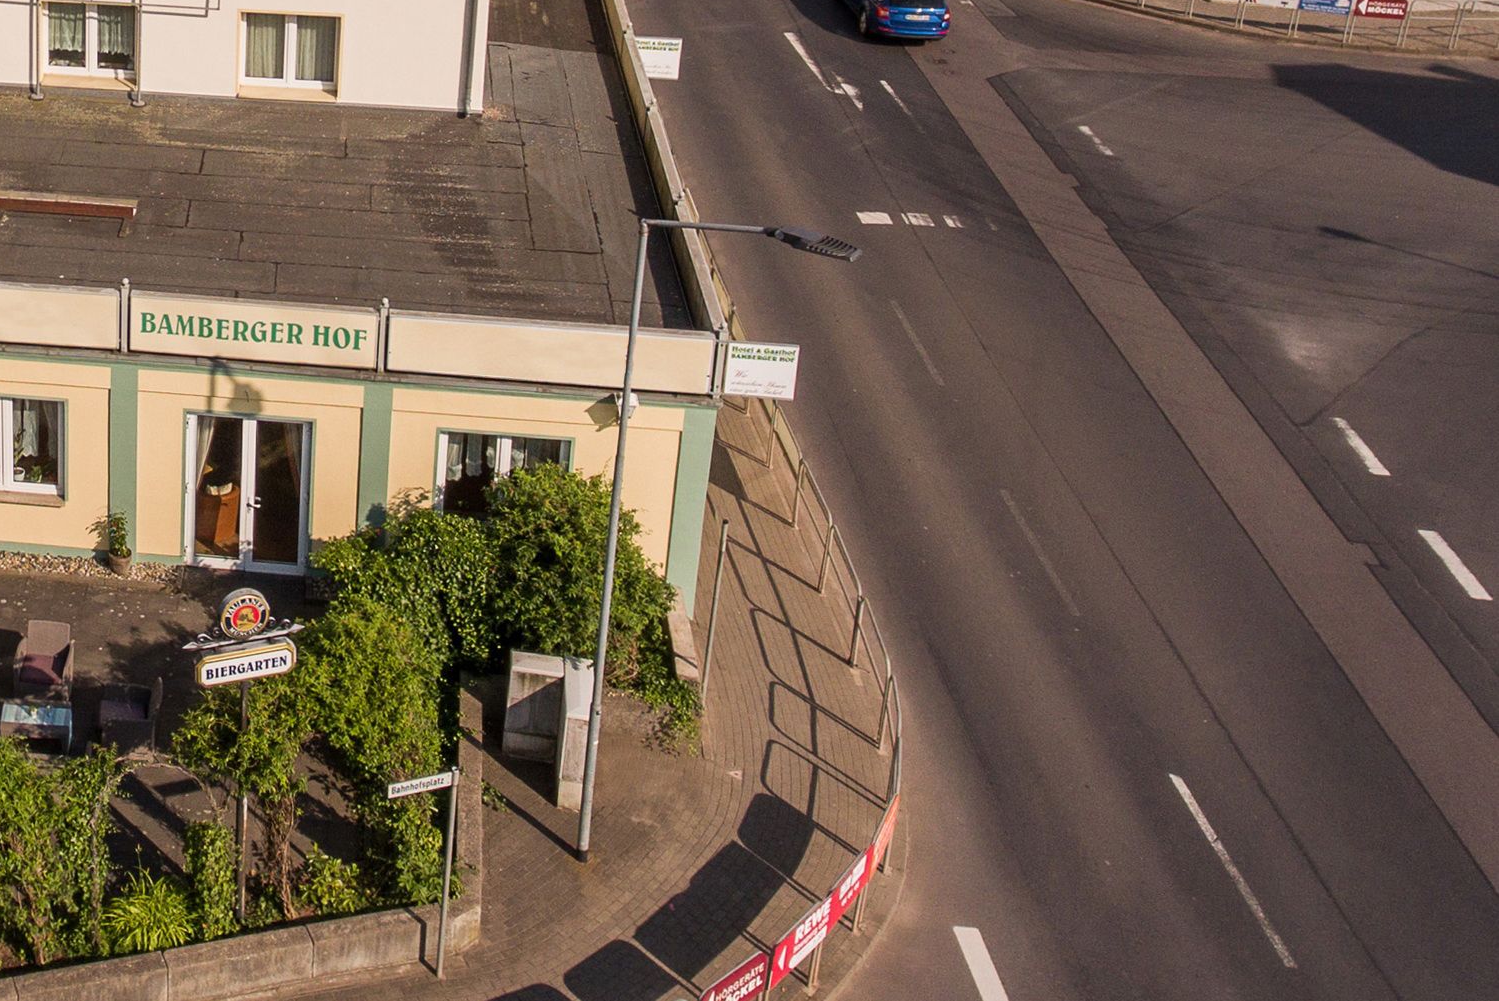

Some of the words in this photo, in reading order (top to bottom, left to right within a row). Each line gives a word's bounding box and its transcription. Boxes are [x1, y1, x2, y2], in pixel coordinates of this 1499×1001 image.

[1367, 6, 1405, 16] MÖCKEL
[140, 312, 303, 345] BAMBERGER
[312, 325, 368, 350] HOF
[731, 353, 777, 361] BAMBERGER
[732, 345, 754, 353] Hotel
[763, 347, 796, 355] Gasthof
[225, 598, 265, 617] PAULANER
[206, 655, 288, 680] BIERGARTEN
[391, 777, 444, 794] Bahnhofsplatz
[794, 898, 833, 944] REWE
[725, 975, 763, 1001] ÖCKEL
